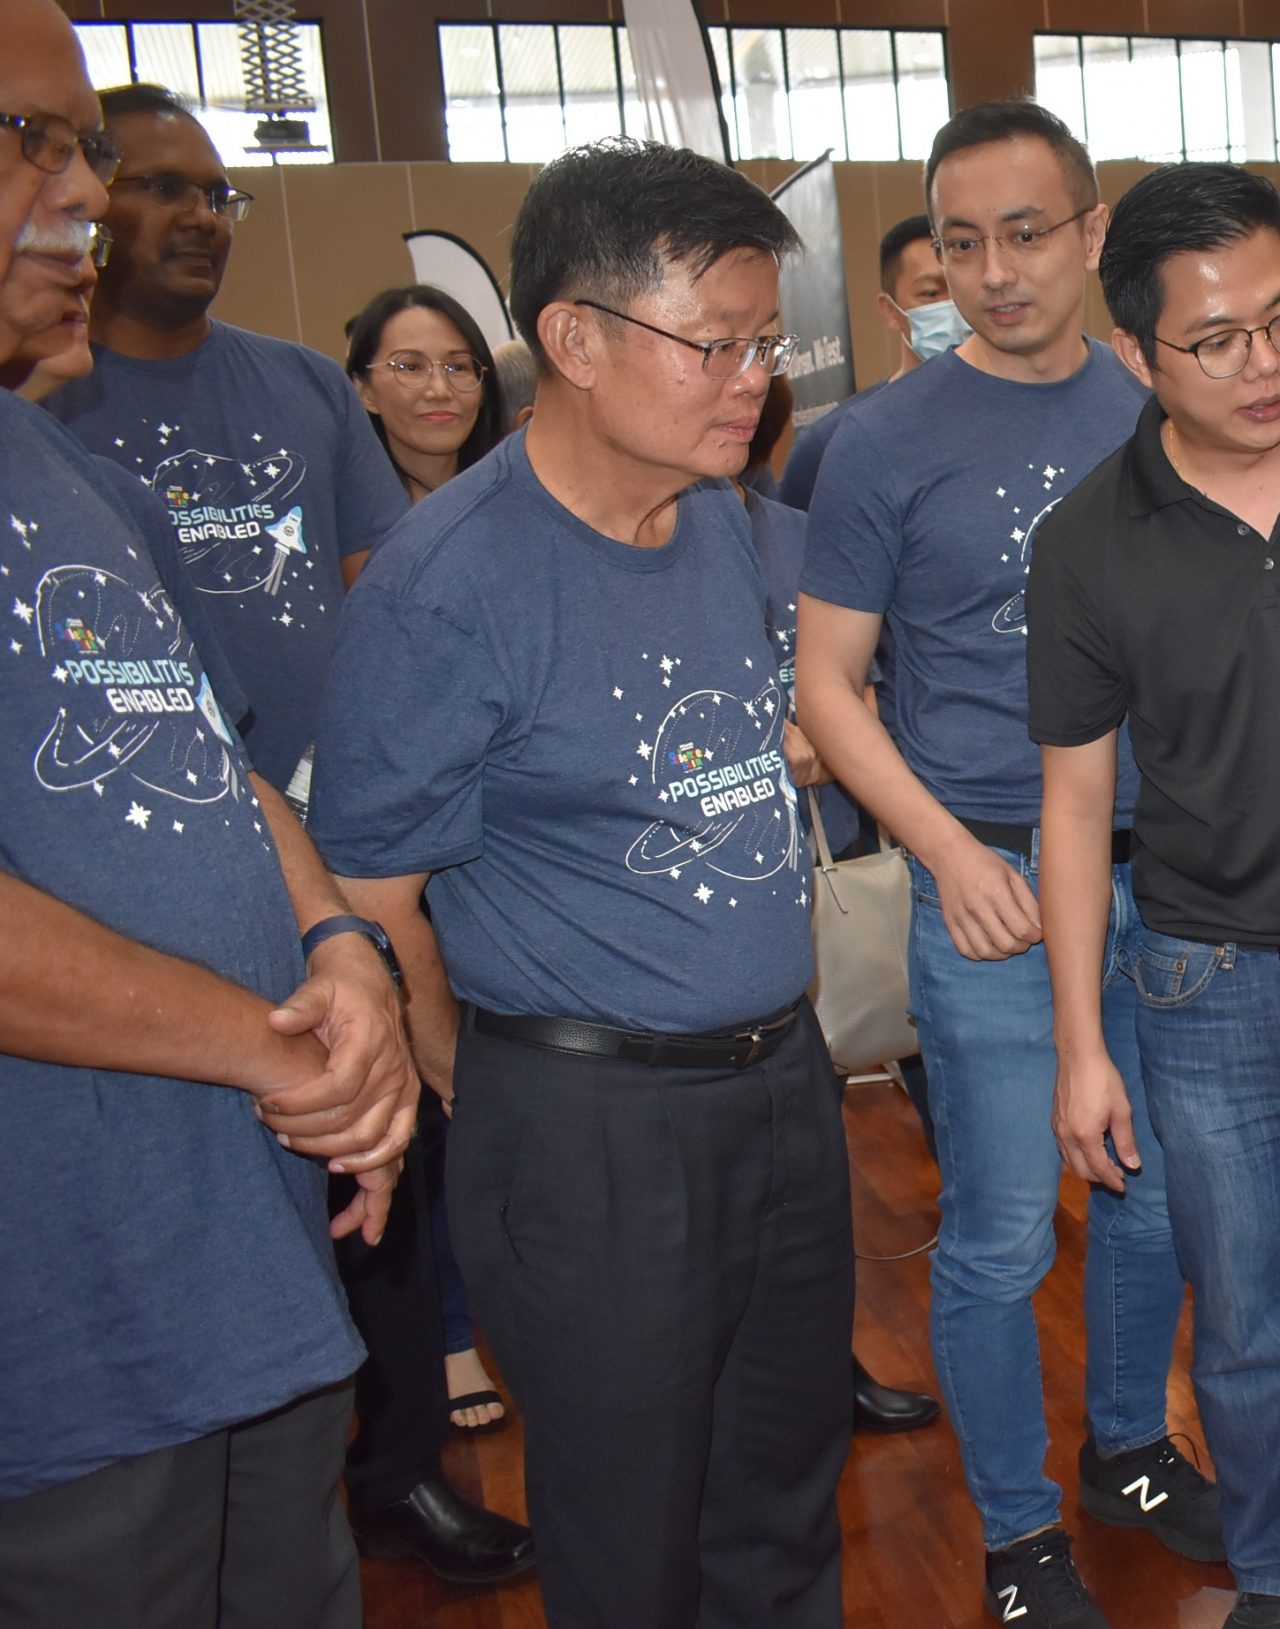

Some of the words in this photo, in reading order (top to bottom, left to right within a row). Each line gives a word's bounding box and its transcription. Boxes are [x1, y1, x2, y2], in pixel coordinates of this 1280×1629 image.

[167, 504, 275, 526] OSSIBILITIES
[178, 521, 261, 543] ENABLED
[106, 688, 195, 713] ENABLED
[668, 750, 783, 803] POSSIBILITIES
[700, 777, 776, 818] ENABLED
